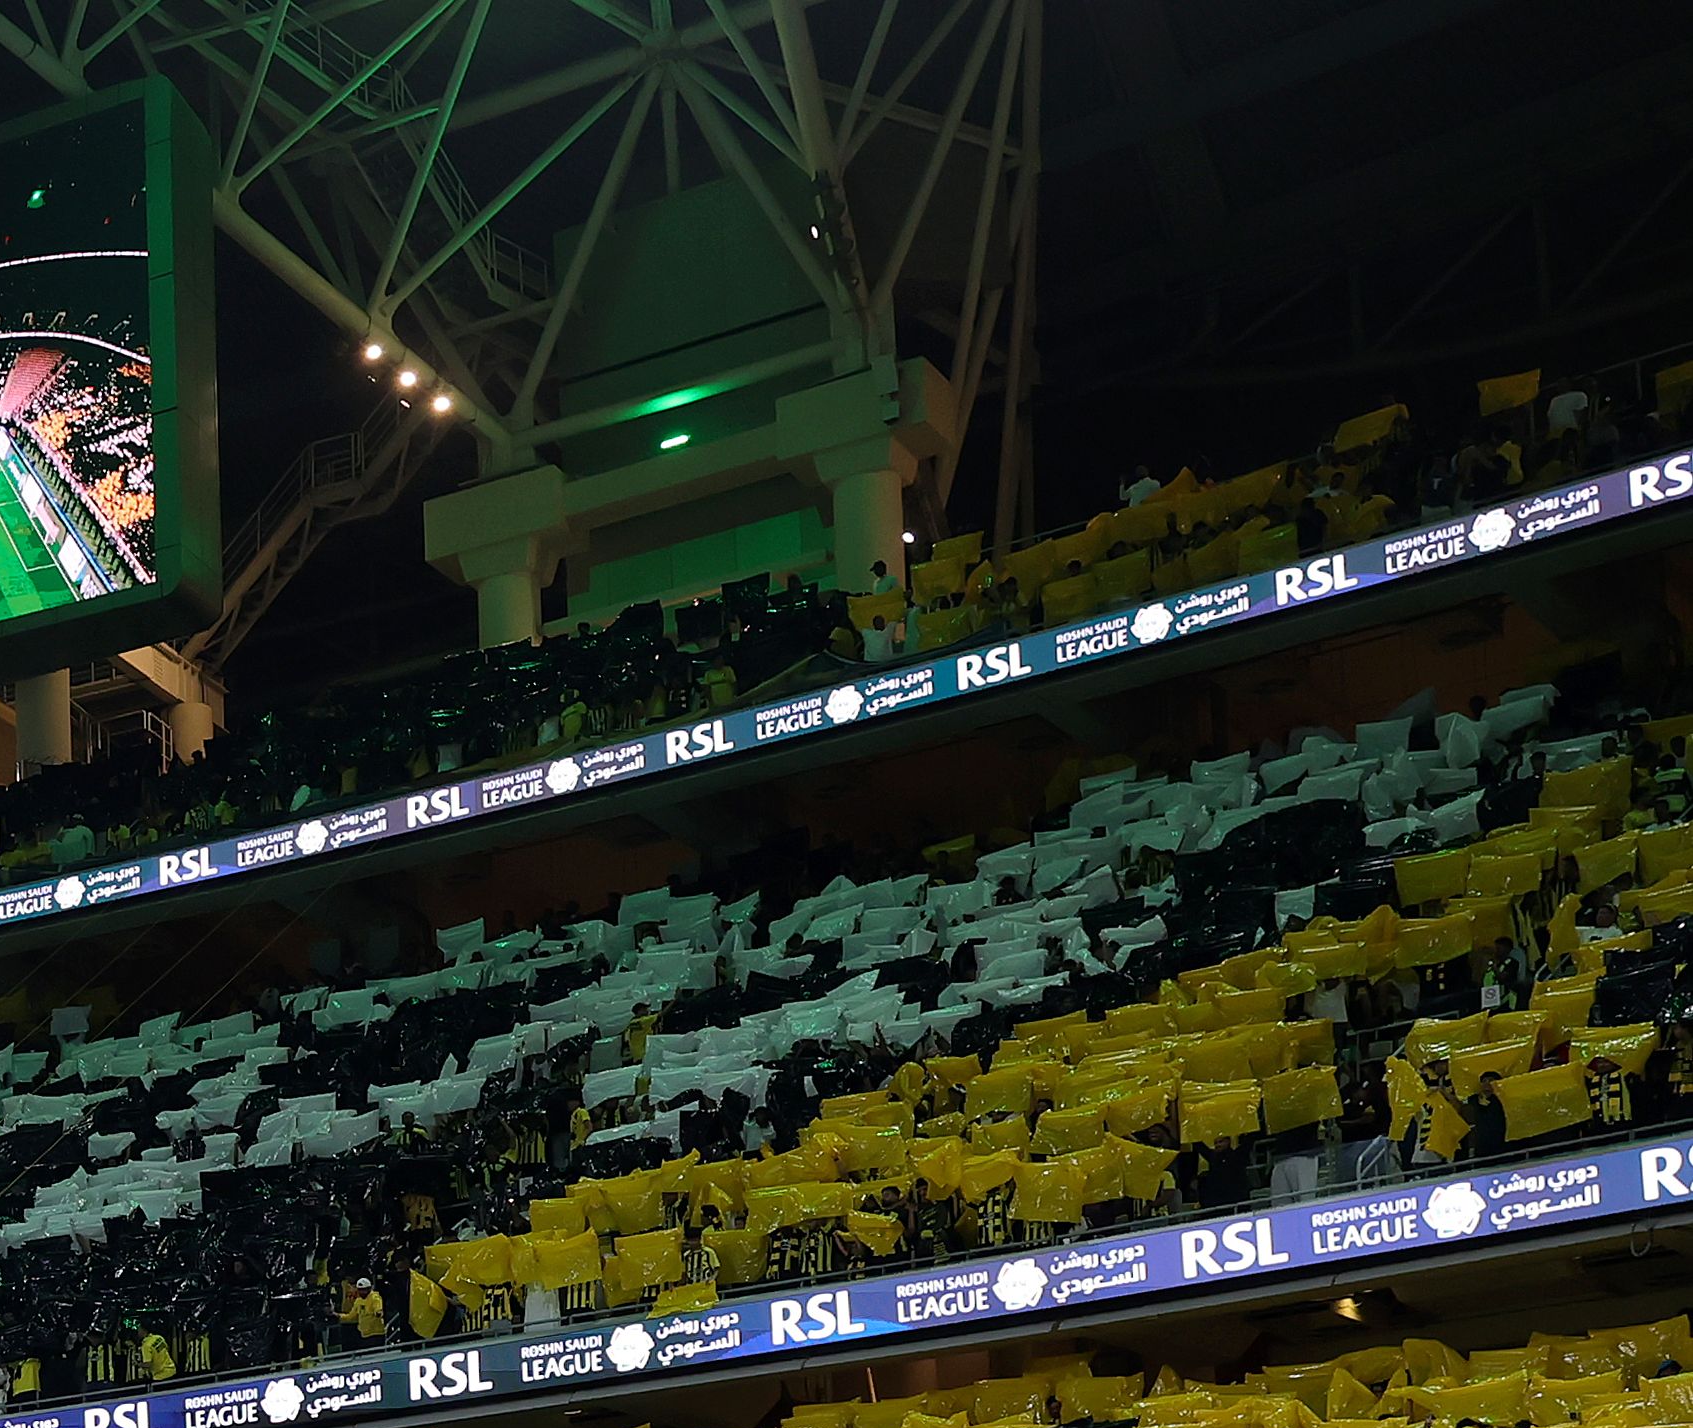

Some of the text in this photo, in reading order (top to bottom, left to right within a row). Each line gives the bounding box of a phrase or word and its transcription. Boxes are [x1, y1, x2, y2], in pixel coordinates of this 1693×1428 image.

[1519, 499, 1599, 541] السعودي
[1385, 524, 1464, 554] ROSHN SAUDI
[1386, 536, 1465, 574] LEAGUE
[1276, 555, 1358, 605] RSL
[1095, 617, 1127, 634] SAUDI
[1057, 629, 1128, 662] LEAGUE
[958, 644, 1031, 690] RSL
[757, 709, 822, 740] LEAGUE
[407, 787, 469, 827] RSL
[238, 841, 294, 867] LEAGUE
[1489, 1166, 1598, 1199] دوري روشن
[1313, 1192, 1416, 1227] ROSHN SAUDI
[1491, 1184, 1600, 1230] السعودي
[1182, 1218, 1288, 1278] RSL
[1314, 1212, 1419, 1254] LEAGUE
[1050, 1245, 1144, 1274] دوري روشن
[897, 1271, 988, 1298] ROSHN SAUDI
[1052, 1262, 1146, 1303] السعودي
[898, 1286, 990, 1323] LEAGUE
[410, 1351, 492, 1400] RSL
[224, 1388, 258, 1403] SAUDI
